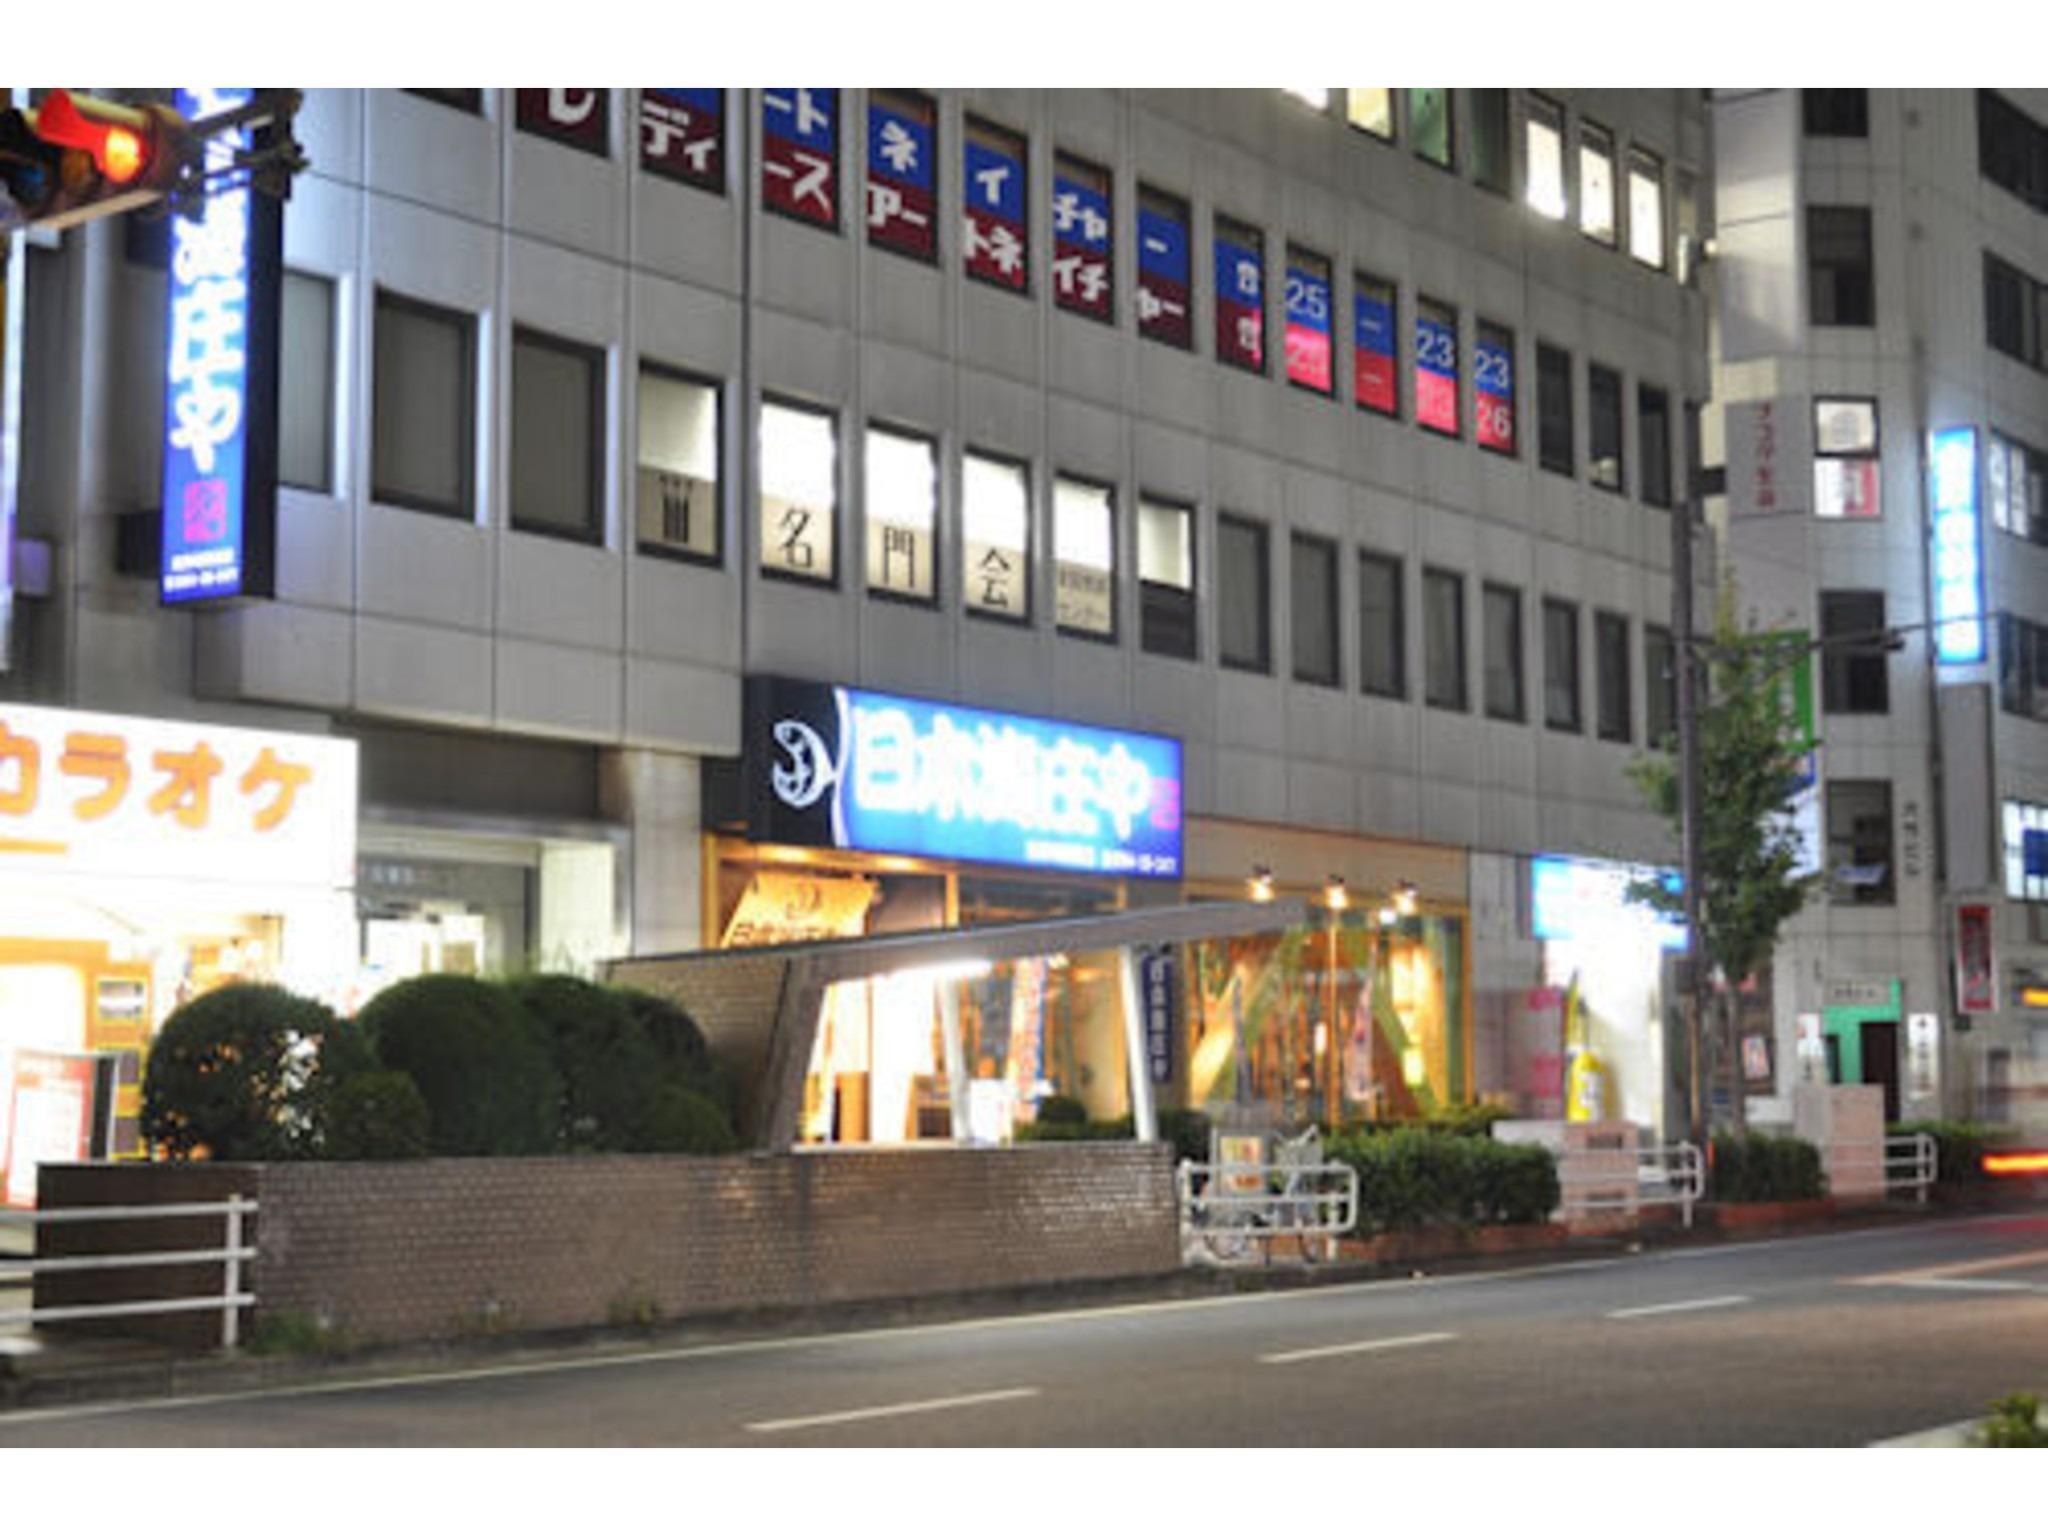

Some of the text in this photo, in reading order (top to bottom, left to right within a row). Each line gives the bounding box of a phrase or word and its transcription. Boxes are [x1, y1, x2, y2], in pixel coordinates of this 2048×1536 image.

[1286, 279, 1327, 319] 25
[1417, 327, 1455, 368] 23
[1475, 349, 1509, 390] 23
[0, 719, 314, 832] カラオケ
